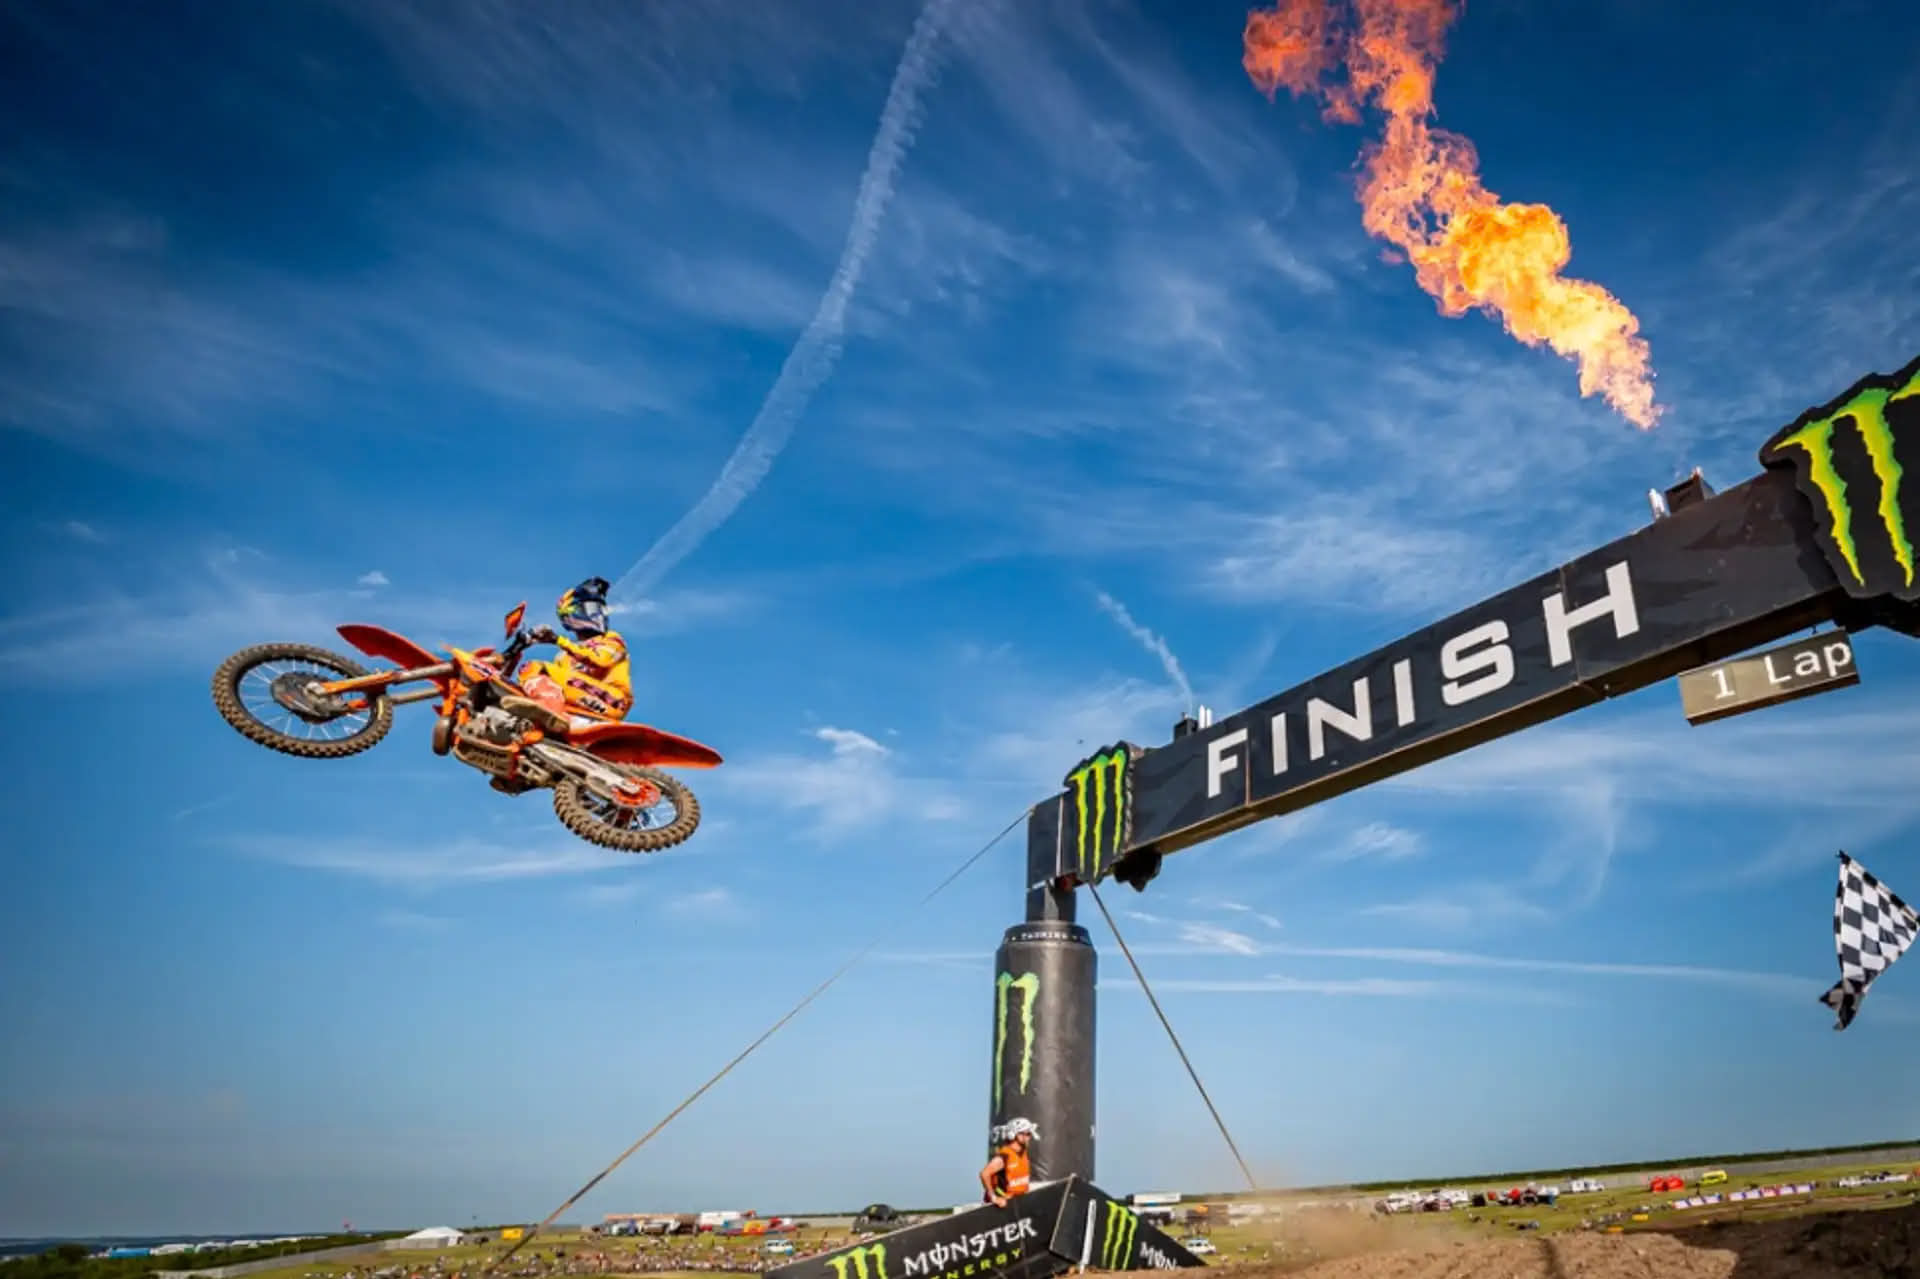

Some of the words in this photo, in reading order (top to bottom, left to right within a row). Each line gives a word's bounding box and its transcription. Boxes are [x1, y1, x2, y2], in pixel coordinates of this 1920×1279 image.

[1207, 561, 1639, 798] FINISH
[1712, 668, 1735, 699] 1
[1764, 642, 1852, 684] Lap
[931, 1247, 1021, 1279] NERGY
